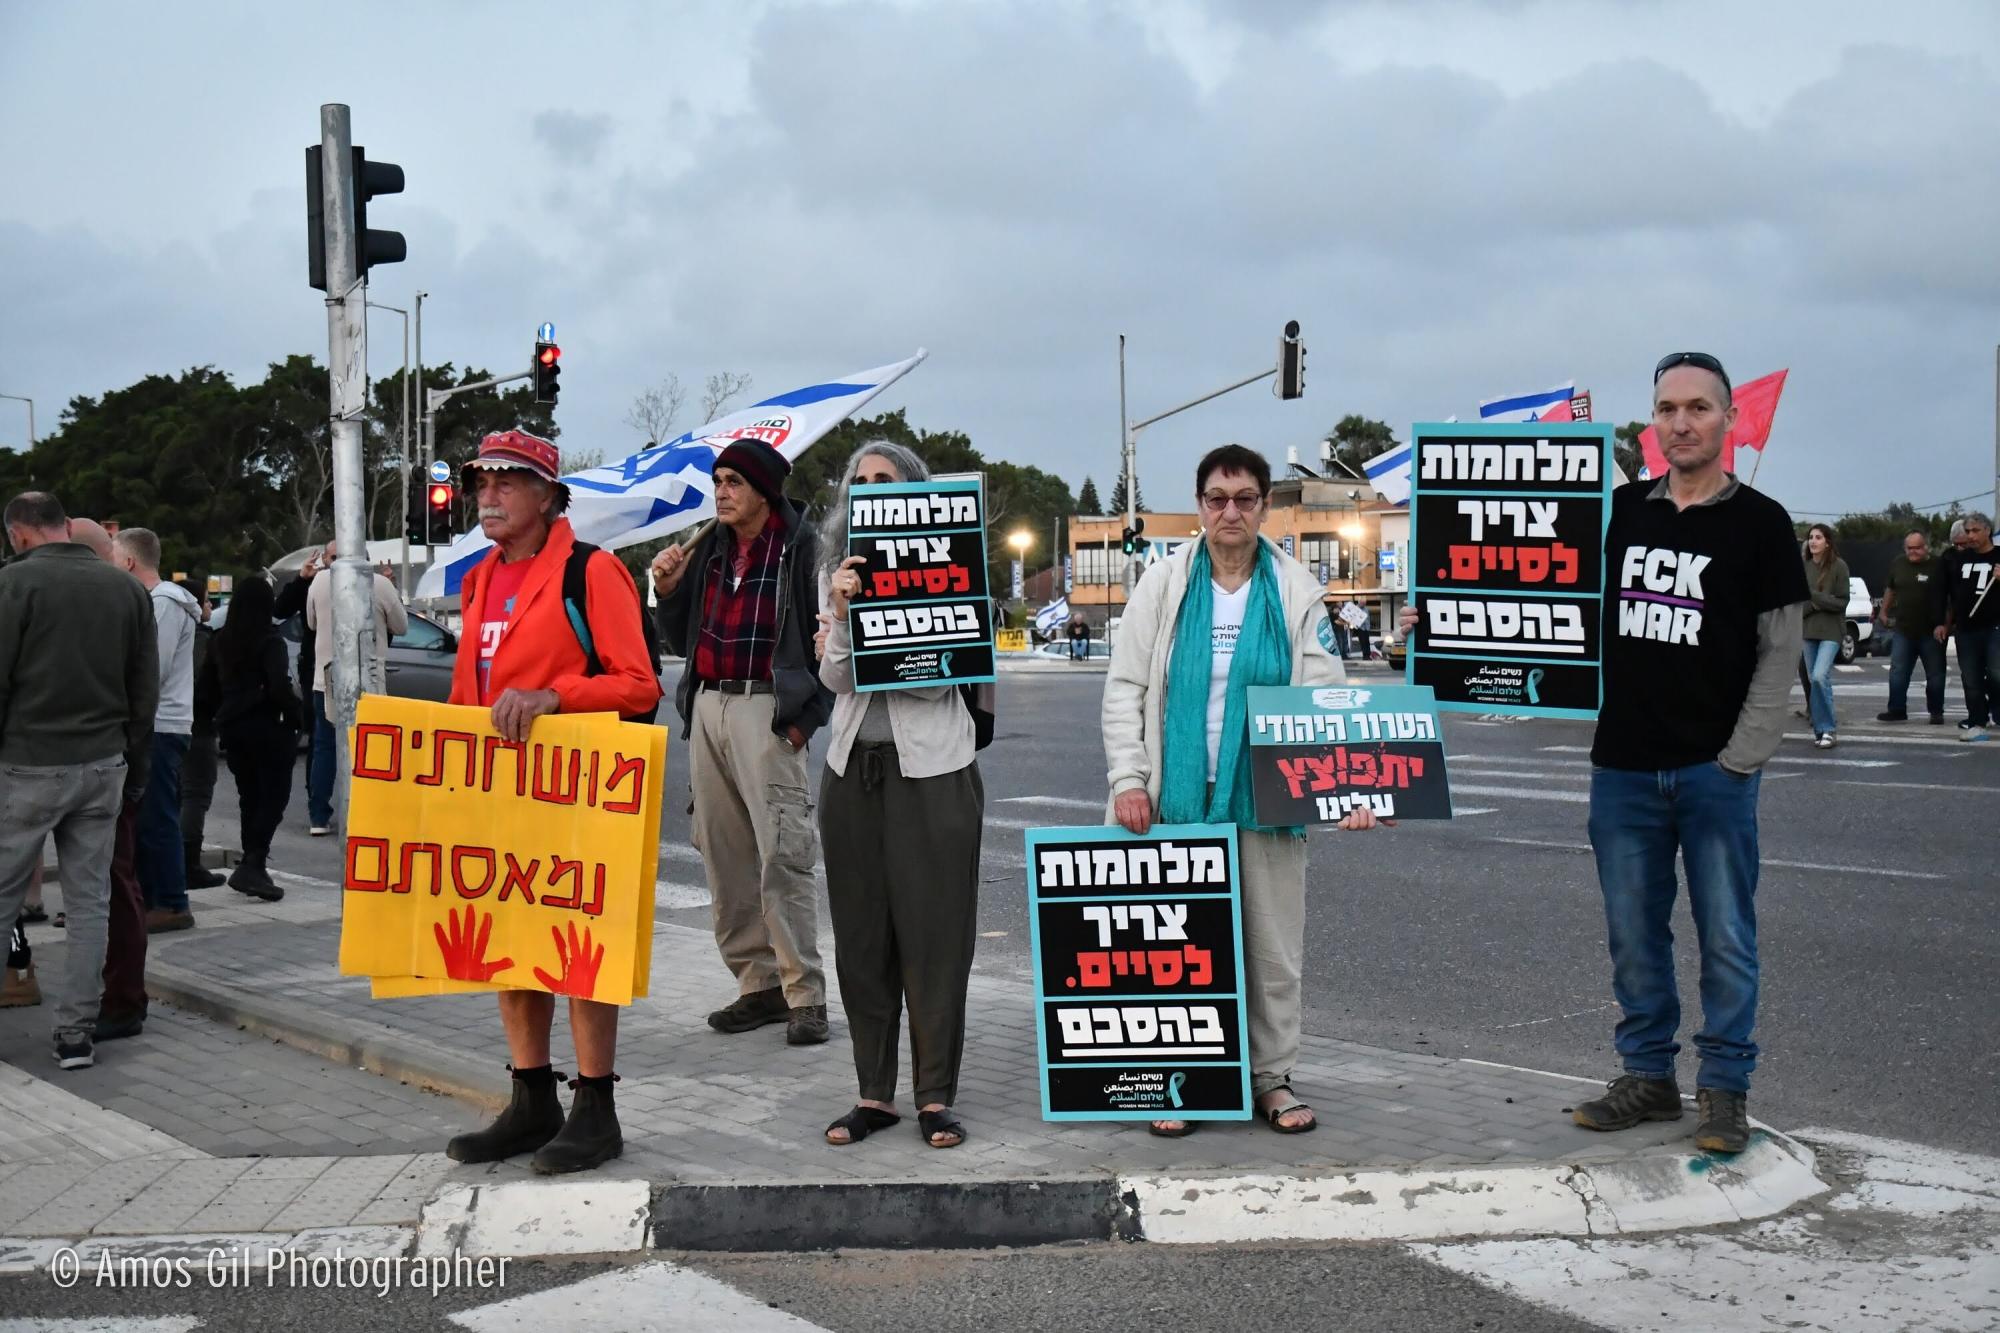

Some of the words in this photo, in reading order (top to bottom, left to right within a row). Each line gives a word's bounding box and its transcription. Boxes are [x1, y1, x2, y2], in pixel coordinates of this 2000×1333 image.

[1572, 407, 1588, 417] נגד
[1421, 439, 1599, 481] מלחמות
[852, 494, 977, 526] מלחמות
[1458, 500, 1558, 541] צריך
[875, 536, 952, 568] צריך
[1437, 542, 1578, 583] לסיים.
[865, 563, 970, 597] לסיים.
[1621, 546, 1712, 600] FCK
[859, 605, 980, 637] בהסכם
[1426, 599, 1585, 641] בהסכם
[1619, 600, 1702, 646] WAR
[1255, 714, 1347, 742] היהודי
[1352, 713, 1436, 739] הטרור
[1277, 746, 1424, 798] יתפוצץ
[1316, 792, 1395, 820] עלינו
[1040, 842, 1225, 887] מלחמות
[1083, 904, 1189, 947] צריך
[1066, 944, 1213, 988] לסיים.
[1057, 1006, 1225, 1044] בהסכם
[1134, 1083, 1164, 1091] עושות
